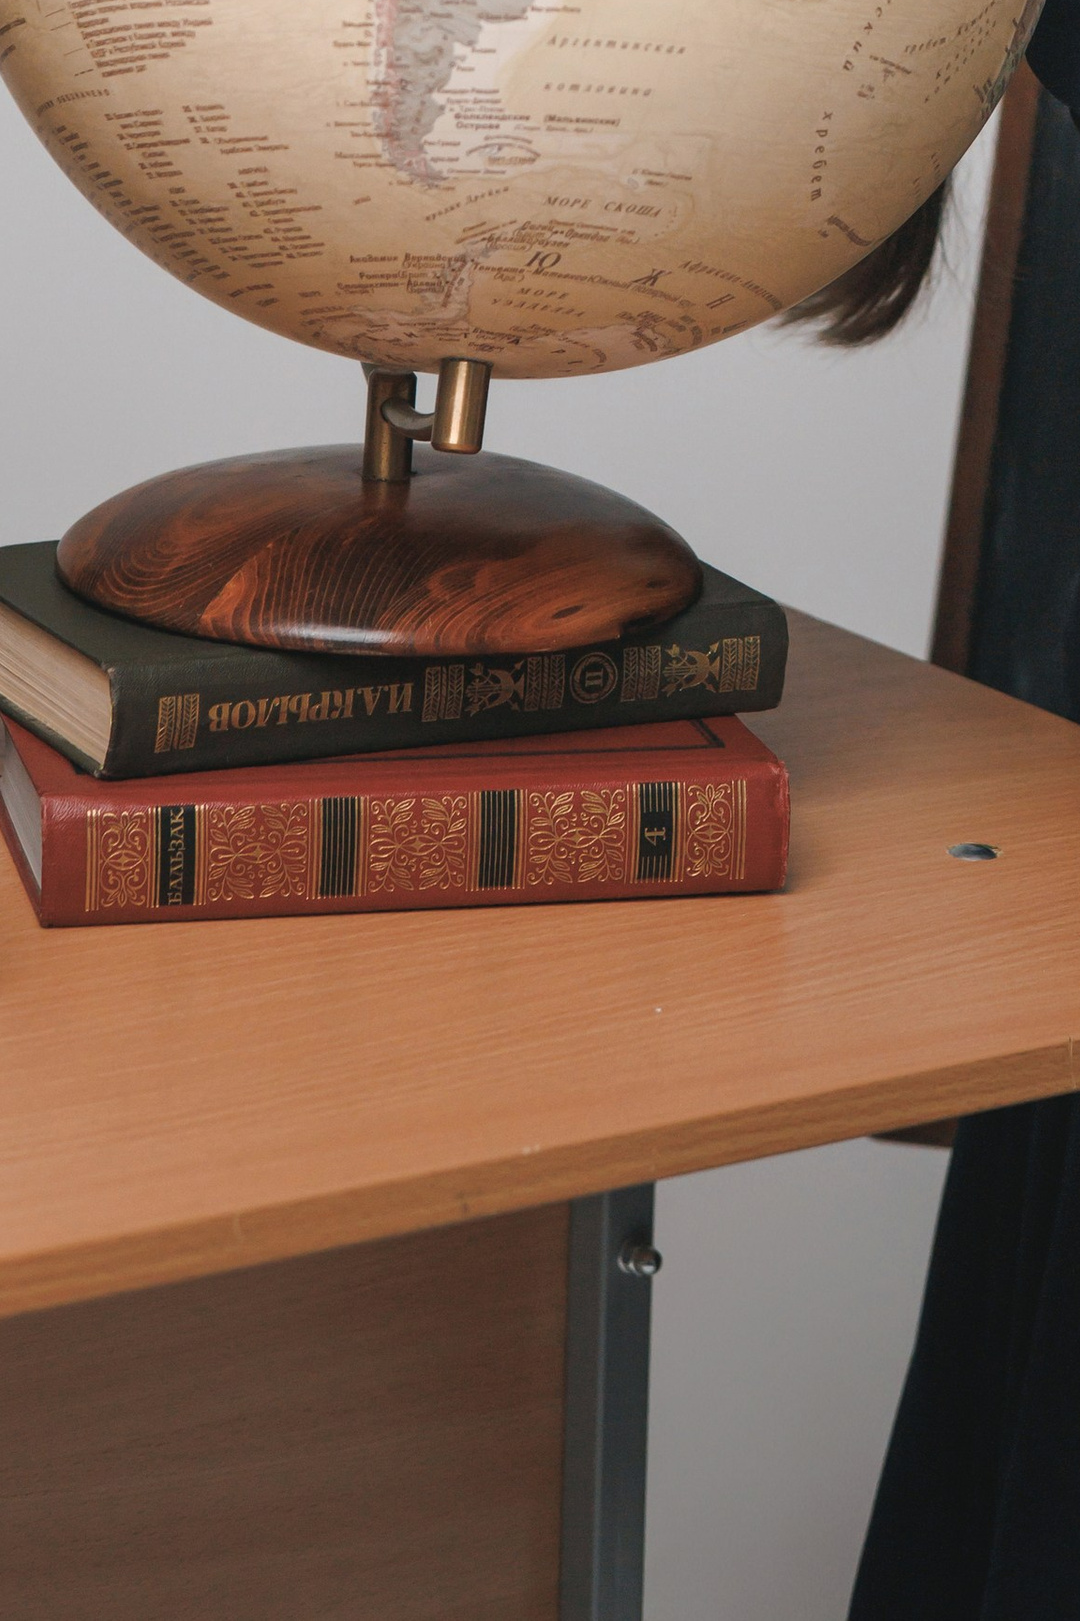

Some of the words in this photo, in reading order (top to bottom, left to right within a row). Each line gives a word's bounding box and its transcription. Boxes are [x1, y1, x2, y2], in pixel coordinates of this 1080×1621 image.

[546, 34, 687, 55] Аргентинская
[544, 82, 653, 97] котловина
[810, 110, 834, 201] хребет
[543, 196, 592, 210] МОРЕ
[603, 201, 664, 218] СКОША
[644, 826, 667, 846] 4
[167, 807, 186, 906] БАЛЬЗАК
